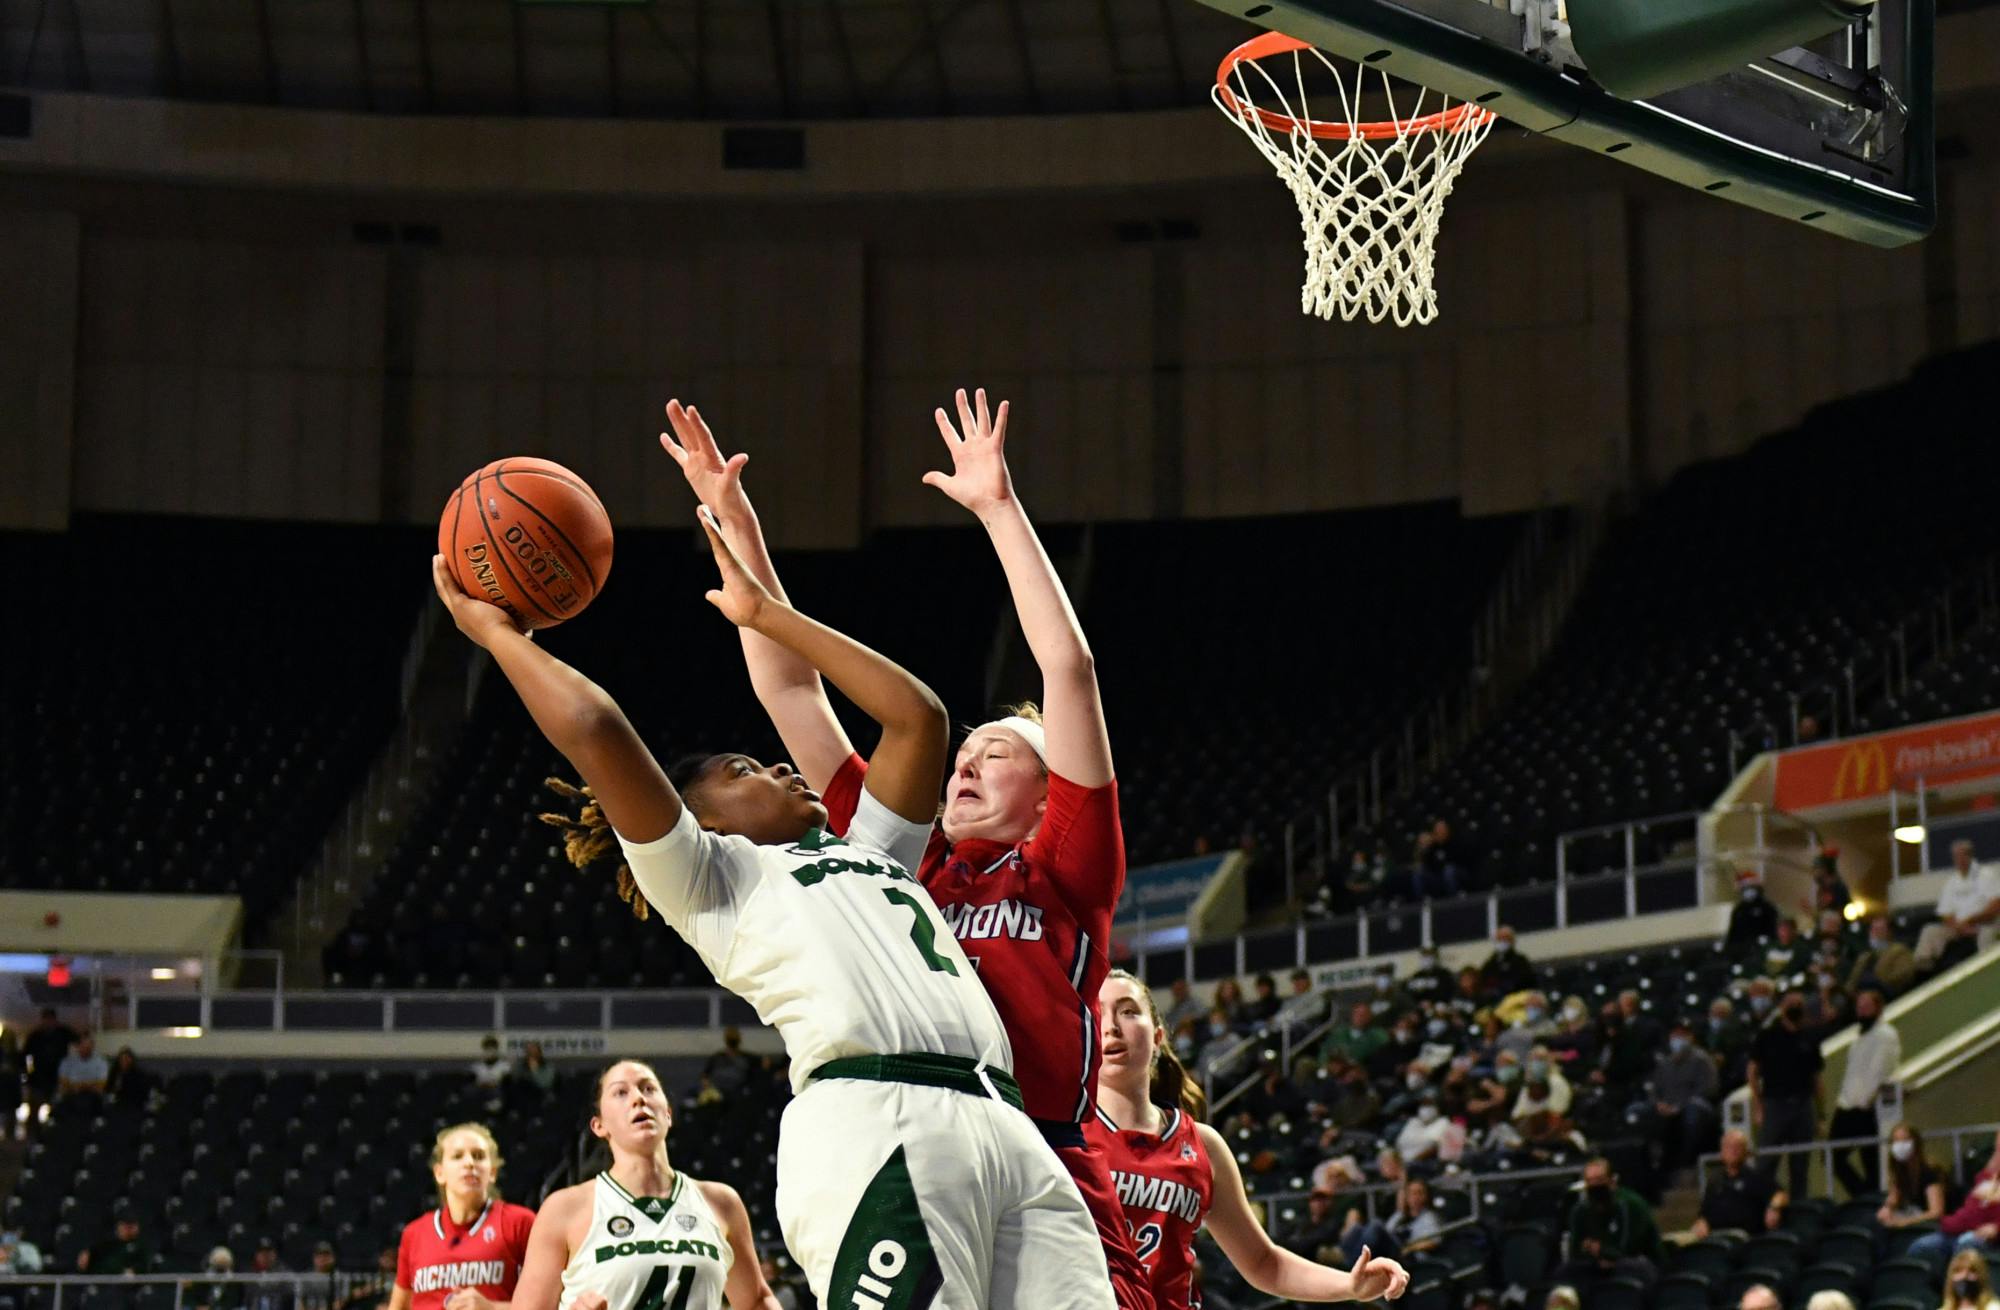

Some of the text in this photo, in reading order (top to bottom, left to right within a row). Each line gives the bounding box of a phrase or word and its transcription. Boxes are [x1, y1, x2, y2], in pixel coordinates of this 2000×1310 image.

[464, 542, 518, 614] LDING
[882, 887, 960, 977] 2
[941, 899, 1043, 941] MOND
[507, 1038, 605, 1051] REERVED
[1109, 1170, 1200, 1224] HMOND
[595, 1239, 720, 1264] BOBCATS
[1126, 1219, 1163, 1261] 2
[413, 1260, 505, 1293] RICHMOND
